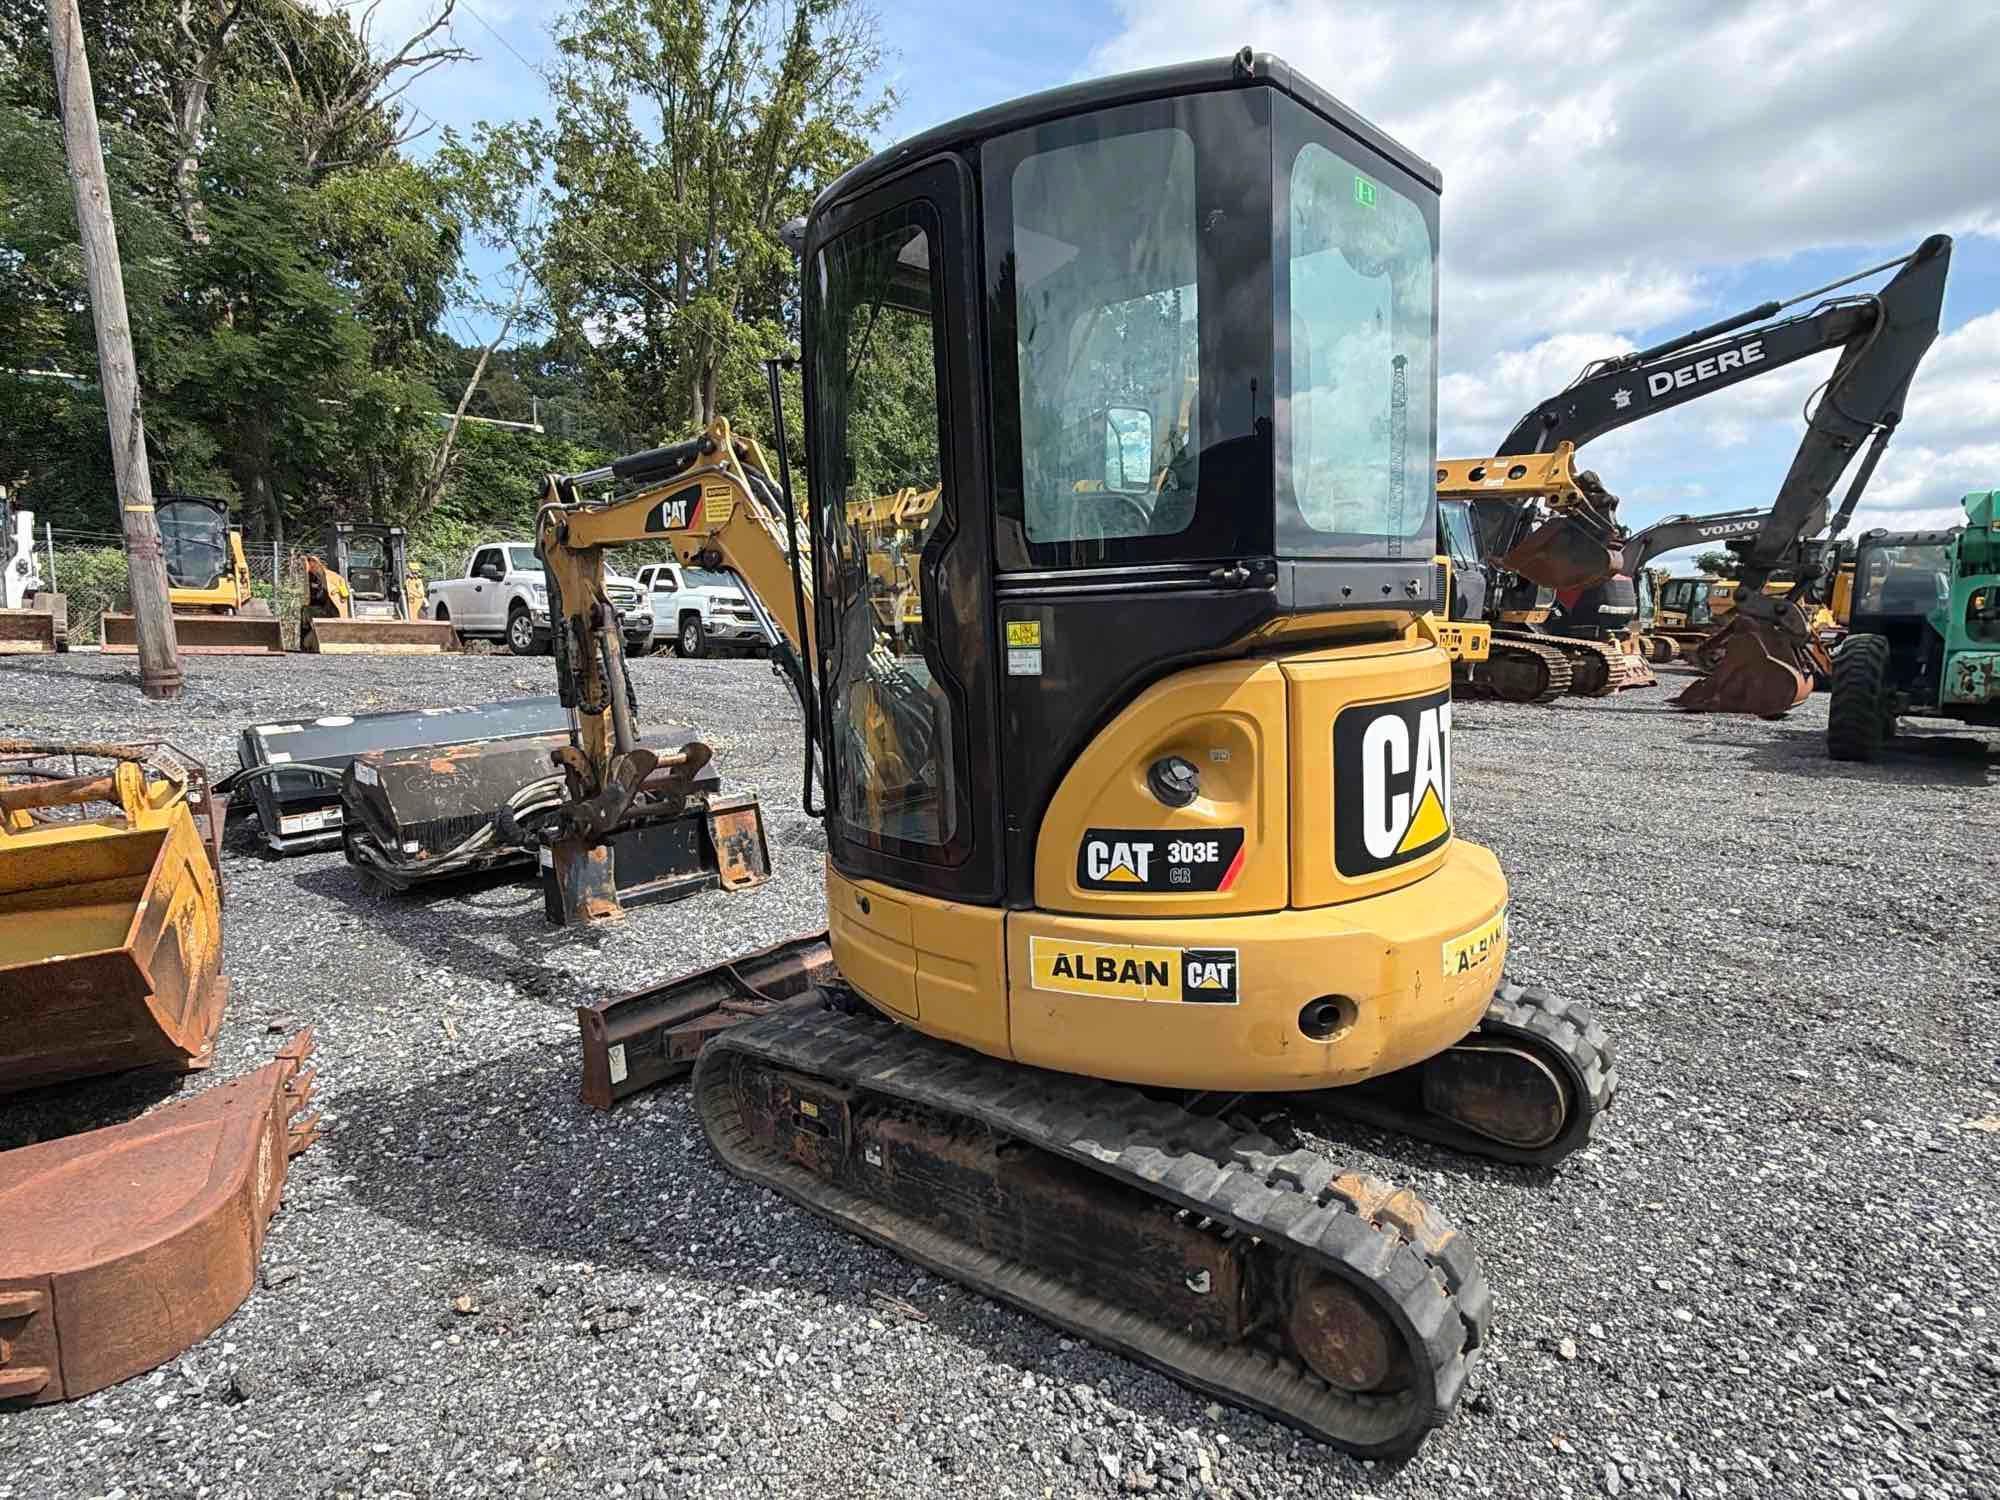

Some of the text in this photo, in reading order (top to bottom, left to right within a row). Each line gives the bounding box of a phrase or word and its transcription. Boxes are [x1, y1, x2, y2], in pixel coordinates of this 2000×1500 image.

[1648, 340, 1765, 397] DEERE
[662, 500, 687, 528] CAT
[1697, 520, 1760, 536] VOLVO
[1087, 840, 1219, 882] CAT 303E
[1169, 867, 1191, 883] CR
[1051, 952, 1233, 989] ALBAN CAT
